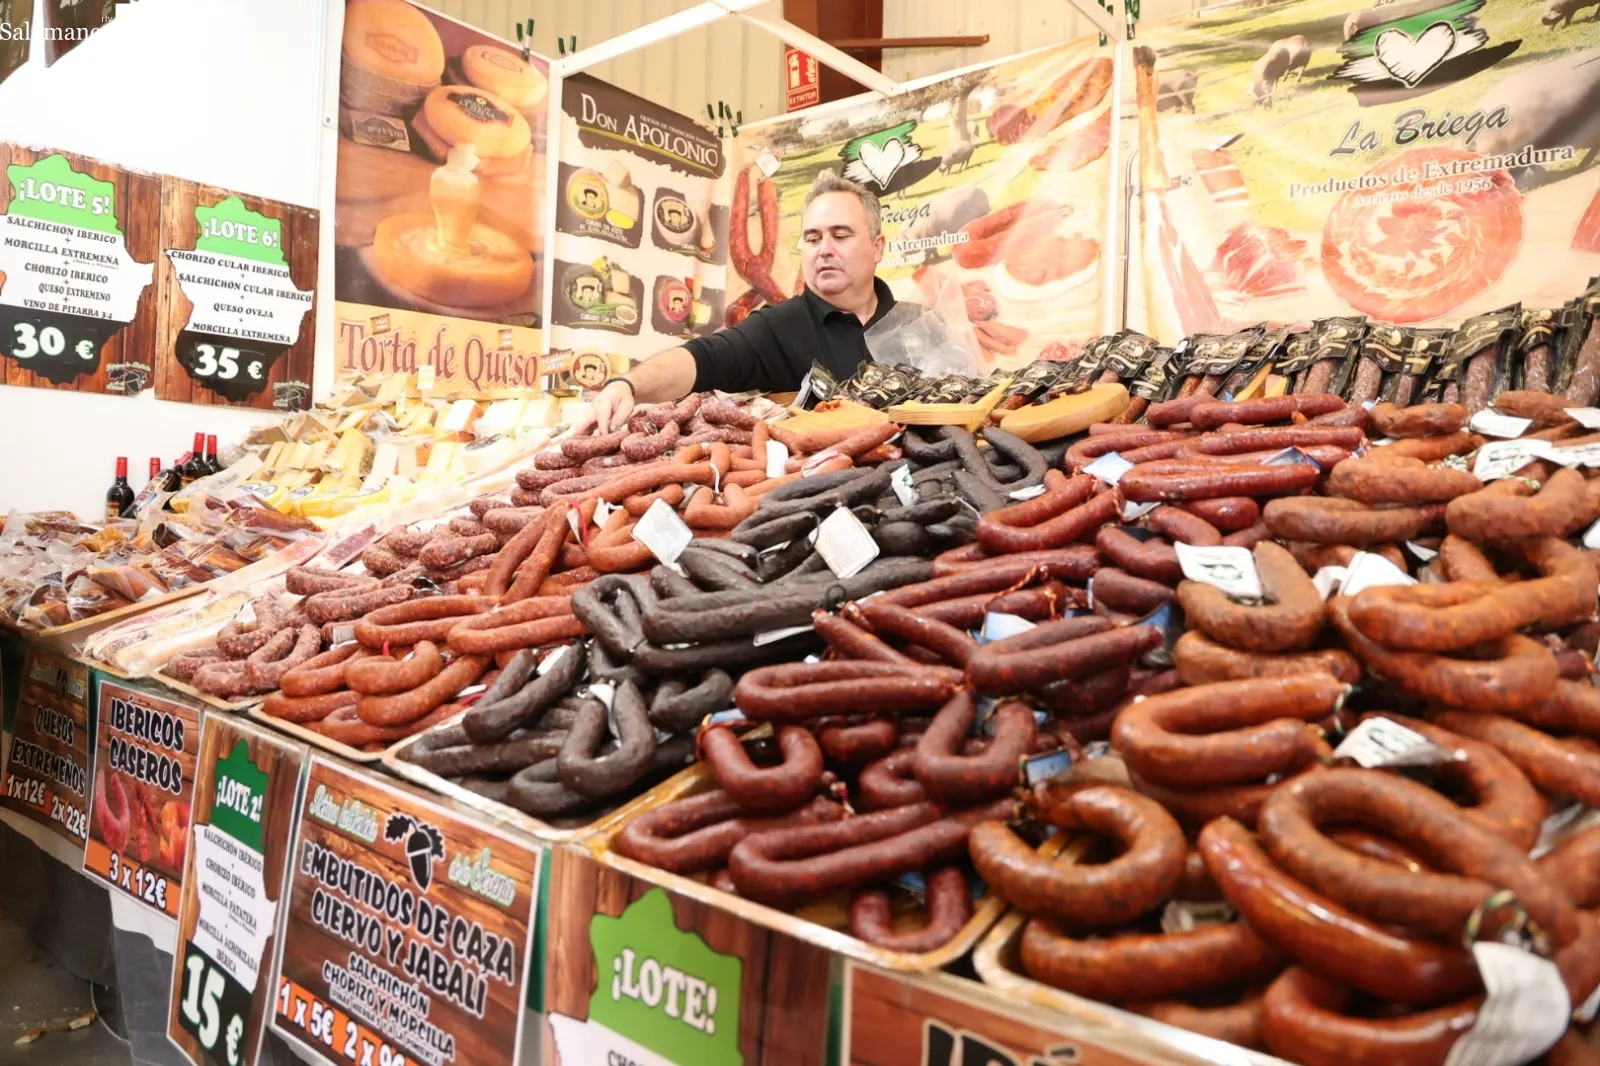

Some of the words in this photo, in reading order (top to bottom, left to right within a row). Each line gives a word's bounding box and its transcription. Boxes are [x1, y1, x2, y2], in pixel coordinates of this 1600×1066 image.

[788, 90, 817, 105] EXTINTOR
[624, 114, 719, 167] APOLONIO
[1329, 120, 1379, 157] La
[1394, 105, 1511, 146] Briega
[1289, 173, 1387, 198] Productos
[1391, 166, 1416, 184] de
[1424, 145, 1574, 180] Extremadura
[1412, 183, 1453, 199] desde
[1456, 178, 1492, 193] 1956
[20, 178, 87, 209] ¡LOTE
[91, 195, 110, 214] 5!
[4, 237, 58, 255] MORCILLA
[204, 217, 258, 244] ¡LOTE
[262, 230, 278, 247] 6!
[888, 231, 969, 252] Extremadura
[25, 262, 68, 277] CHORIZO
[171, 250, 215, 265] CHORIZO
[218, 259, 249, 272] CULAR
[24, 298, 46, 309] VINO
[48, 302, 60, 311] DE
[62, 304, 99, 317] PITARRA
[39, 282, 64, 294] QUESO
[243, 284, 274, 296] CULAR
[192, 322, 239, 336] MORCILLA
[213, 302, 244, 314] QUESO
[246, 307, 274, 318] OVEJA
[13, 322, 66, 358] 30
[75, 340, 94, 360] €
[194, 344, 240, 379] 35
[247, 360, 262, 379] €
[339, 319, 418, 375] Torta
[428, 324, 456, 381] de
[464, 336, 538, 391] Queso
[34, 705, 74, 747] QUESOS
[109, 695, 184, 752] IBÉRICOS
[11, 737, 86, 797] EXTREMEÑOS
[109, 736, 182, 795] CASEROS
[216, 775, 251, 816] ¡LOTE
[249, 794, 263, 823] 2!
[203, 829, 238, 857] SALCHICHÓN
[238, 847, 262, 872] IBÉRICO
[205, 858, 231, 882] CHORIZO
[109, 851, 119, 882] 3
[121, 863, 132, 891] x
[135, 866, 167, 910] 12€
[202, 881, 228, 909] MORCILLA
[228, 900, 258, 930] PATATERA
[300, 839, 414, 926] EMBUTIDOS
[416, 896, 449, 946] DE
[451, 915, 515, 987] CAZA
[312, 887, 382, 956] CIERVO
[386, 926, 404, 966] Y
[403, 939, 488, 1019] JABALÍ
[349, 951, 431, 1018] SALCHICHÓN
[612, 947, 718, 1036] ¡LOTE!
[182, 954, 225, 1049] 15
[226, 1014, 243, 1066] €
[280, 982, 291, 1017] 1
[294, 997, 308, 1030] x
[310, 1000, 335, 1046] 5€
[343, 1021, 358, 1060] 2
[322, 960, 375, 1007] CHORIZO
[377, 993, 387, 1015] Y
[388, 1000, 456, 1062] MORCILLA
